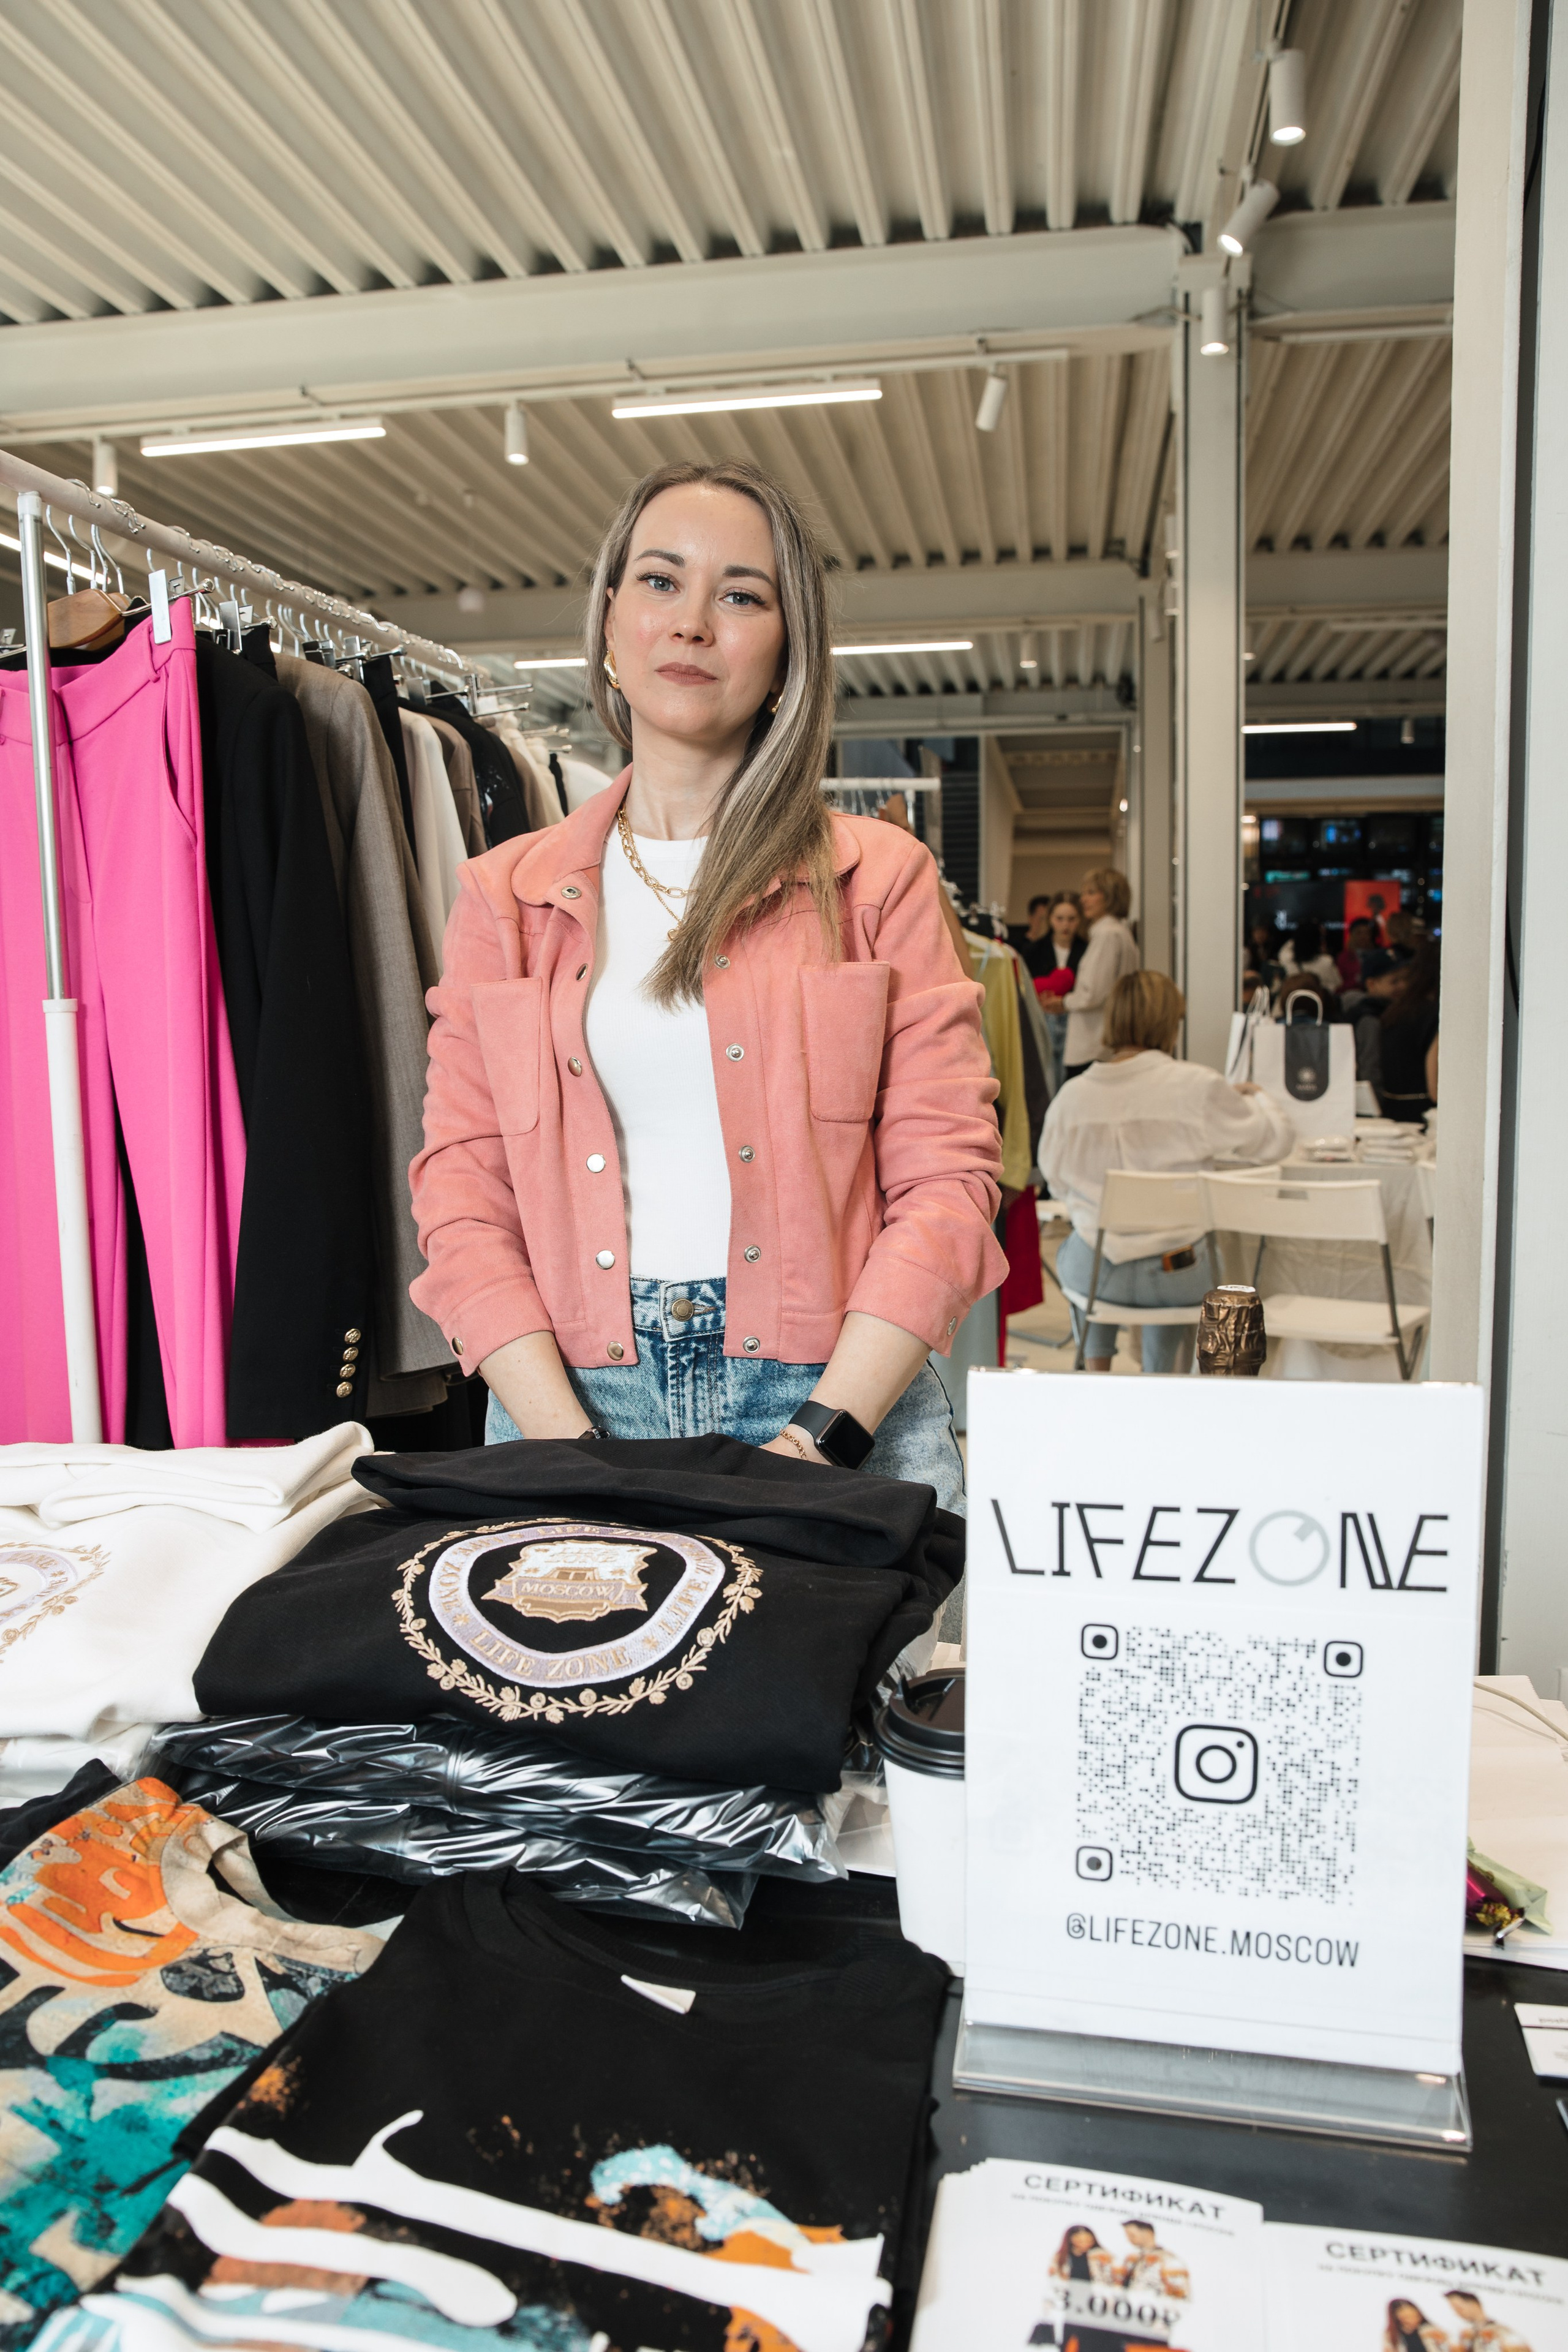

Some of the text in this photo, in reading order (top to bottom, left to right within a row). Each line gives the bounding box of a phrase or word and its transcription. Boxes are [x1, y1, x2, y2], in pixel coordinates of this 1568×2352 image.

[990, 1498, 1449, 1593] LIFEZONE
[521, 1581, 614, 1597] MOSCOW
[658, 1578, 710, 1635] LIFE
[470, 1630, 633, 1679] LIFE ZONE
[1066, 1912, 1359, 1967] @LIFEZONE.MOSCOW
[1023, 2174, 1225, 2220] СЕРТИФИКАТ
[1325, 2241, 1546, 2287] СЕРТИФИКАТ
